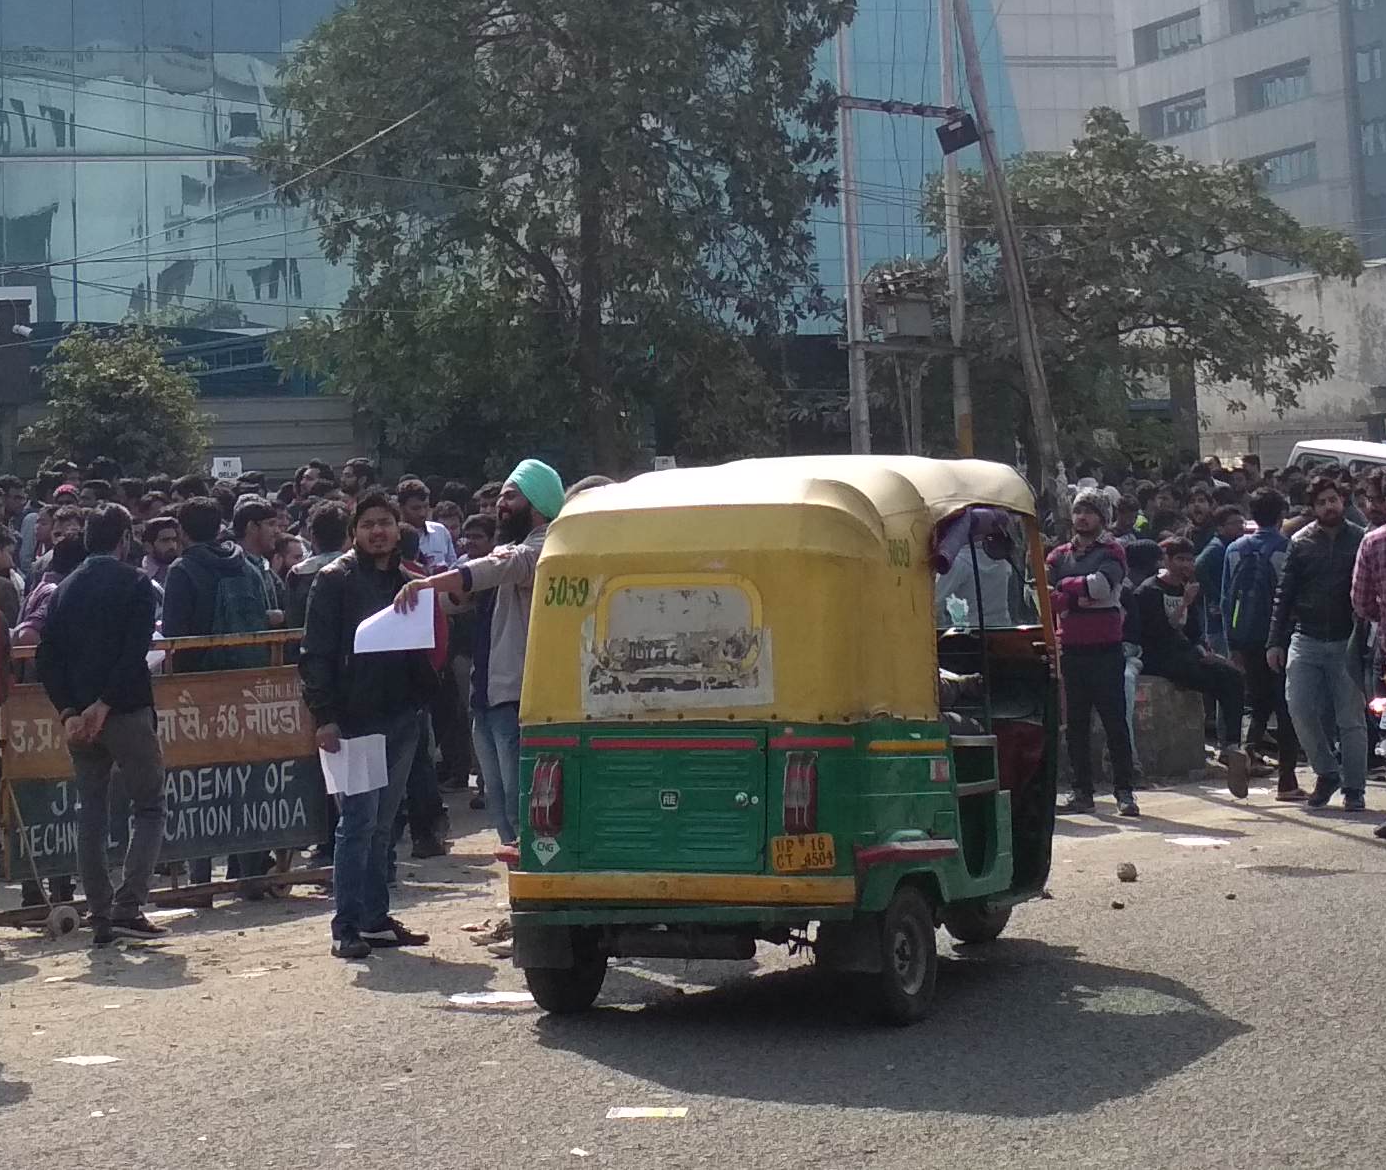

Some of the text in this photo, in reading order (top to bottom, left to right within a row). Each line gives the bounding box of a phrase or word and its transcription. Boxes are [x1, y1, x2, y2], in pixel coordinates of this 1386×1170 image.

[544, 575, 589, 607] 3059
[163, 759, 296, 805] ADEMY OF
[243, 796, 307, 834] NOIDA
[536, 841, 554, 853] CNG
[775, 836, 826, 853] UP 16
[776, 852, 794, 869] CT
